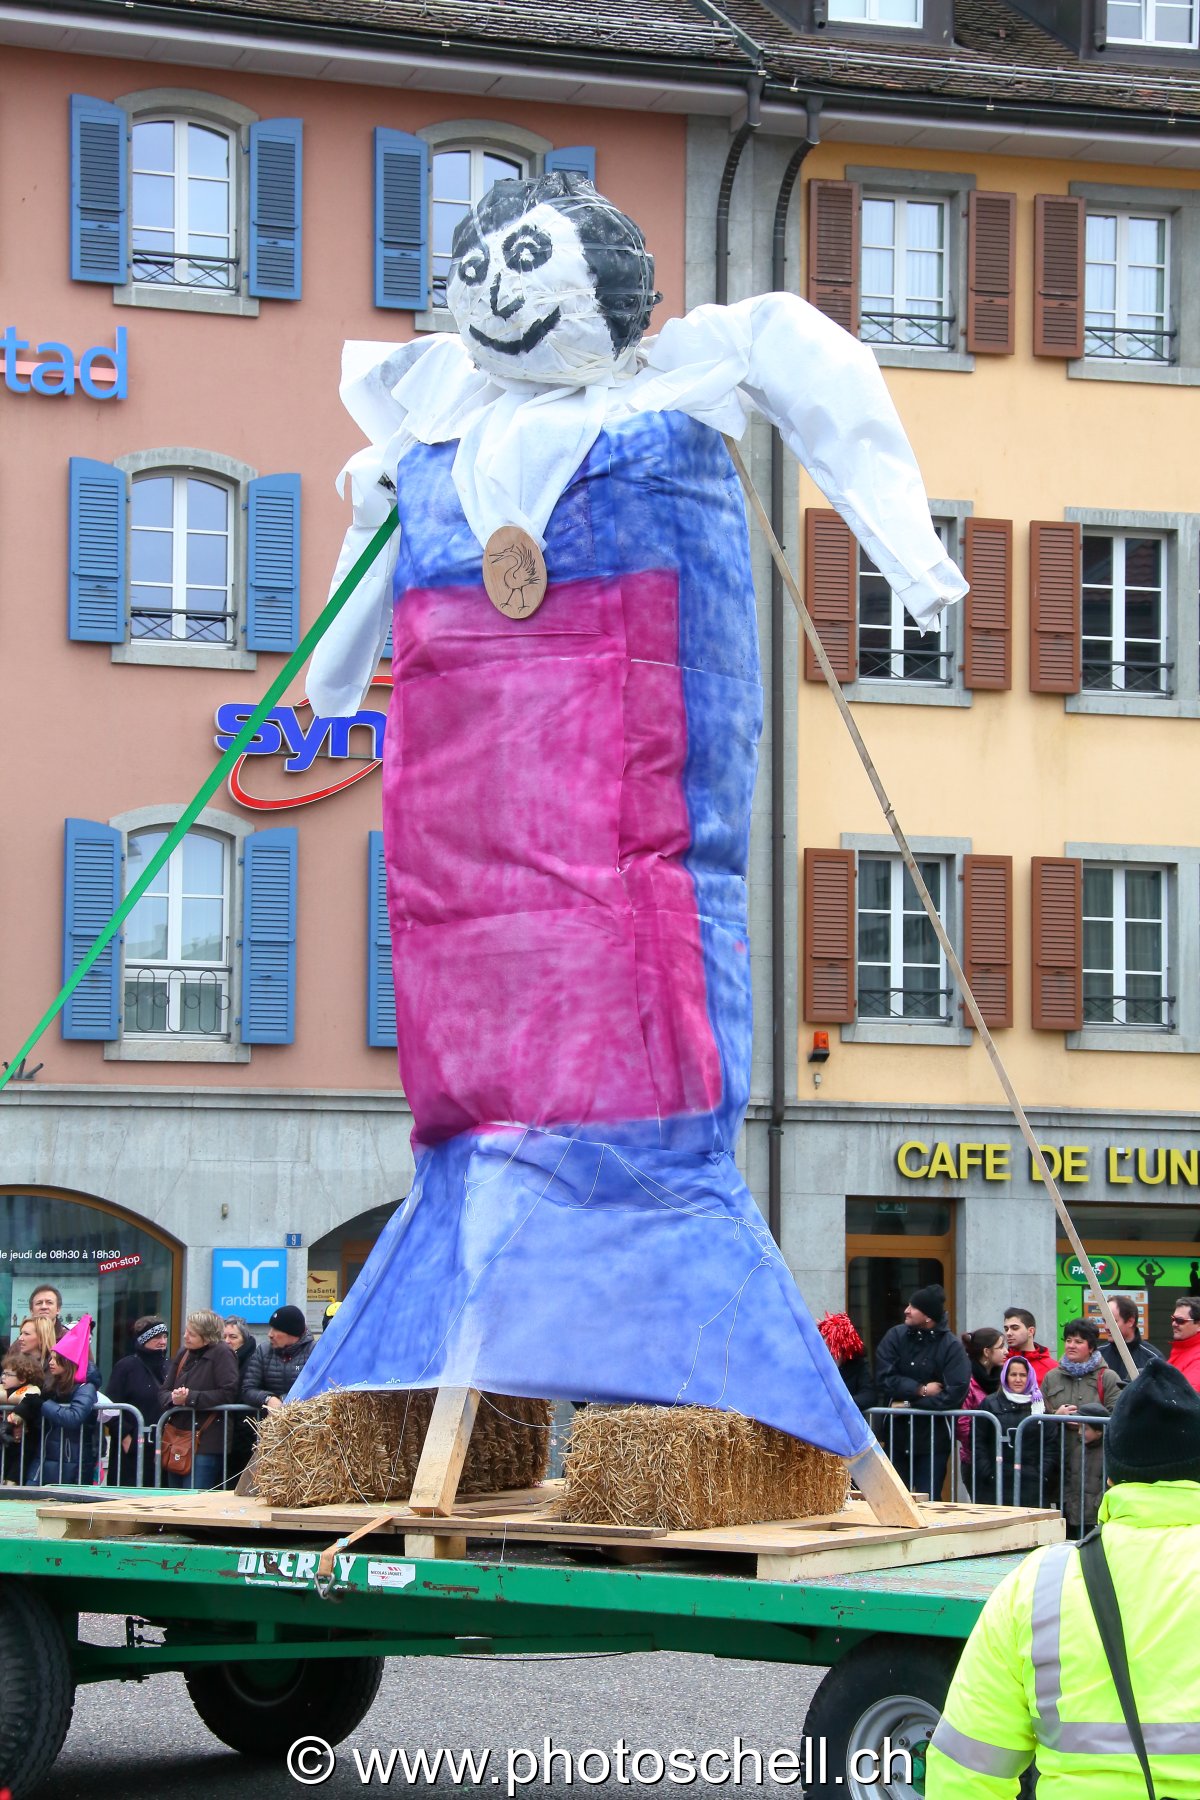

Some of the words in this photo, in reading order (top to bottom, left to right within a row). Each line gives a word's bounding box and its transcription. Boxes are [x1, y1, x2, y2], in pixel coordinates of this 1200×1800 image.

[0, 326, 128, 399] tad
[897, 1141, 1011, 1180] CAFE
[1029, 1145, 1089, 1182] DE
[1109, 1146, 1198, 1185] L'UN
[291, 1234, 297, 1246] 9
[9, 1249, 33, 1262] jeudi
[35, 1250, 47, 1259] de
[49, 1250, 80, 1260] 08h30
[82, 1249, 88, 1259] à
[91, 1250, 121, 1260] 18h30
[100, 1255, 140, 1272] non-stop
[221, 1292, 279, 1306] randstad
